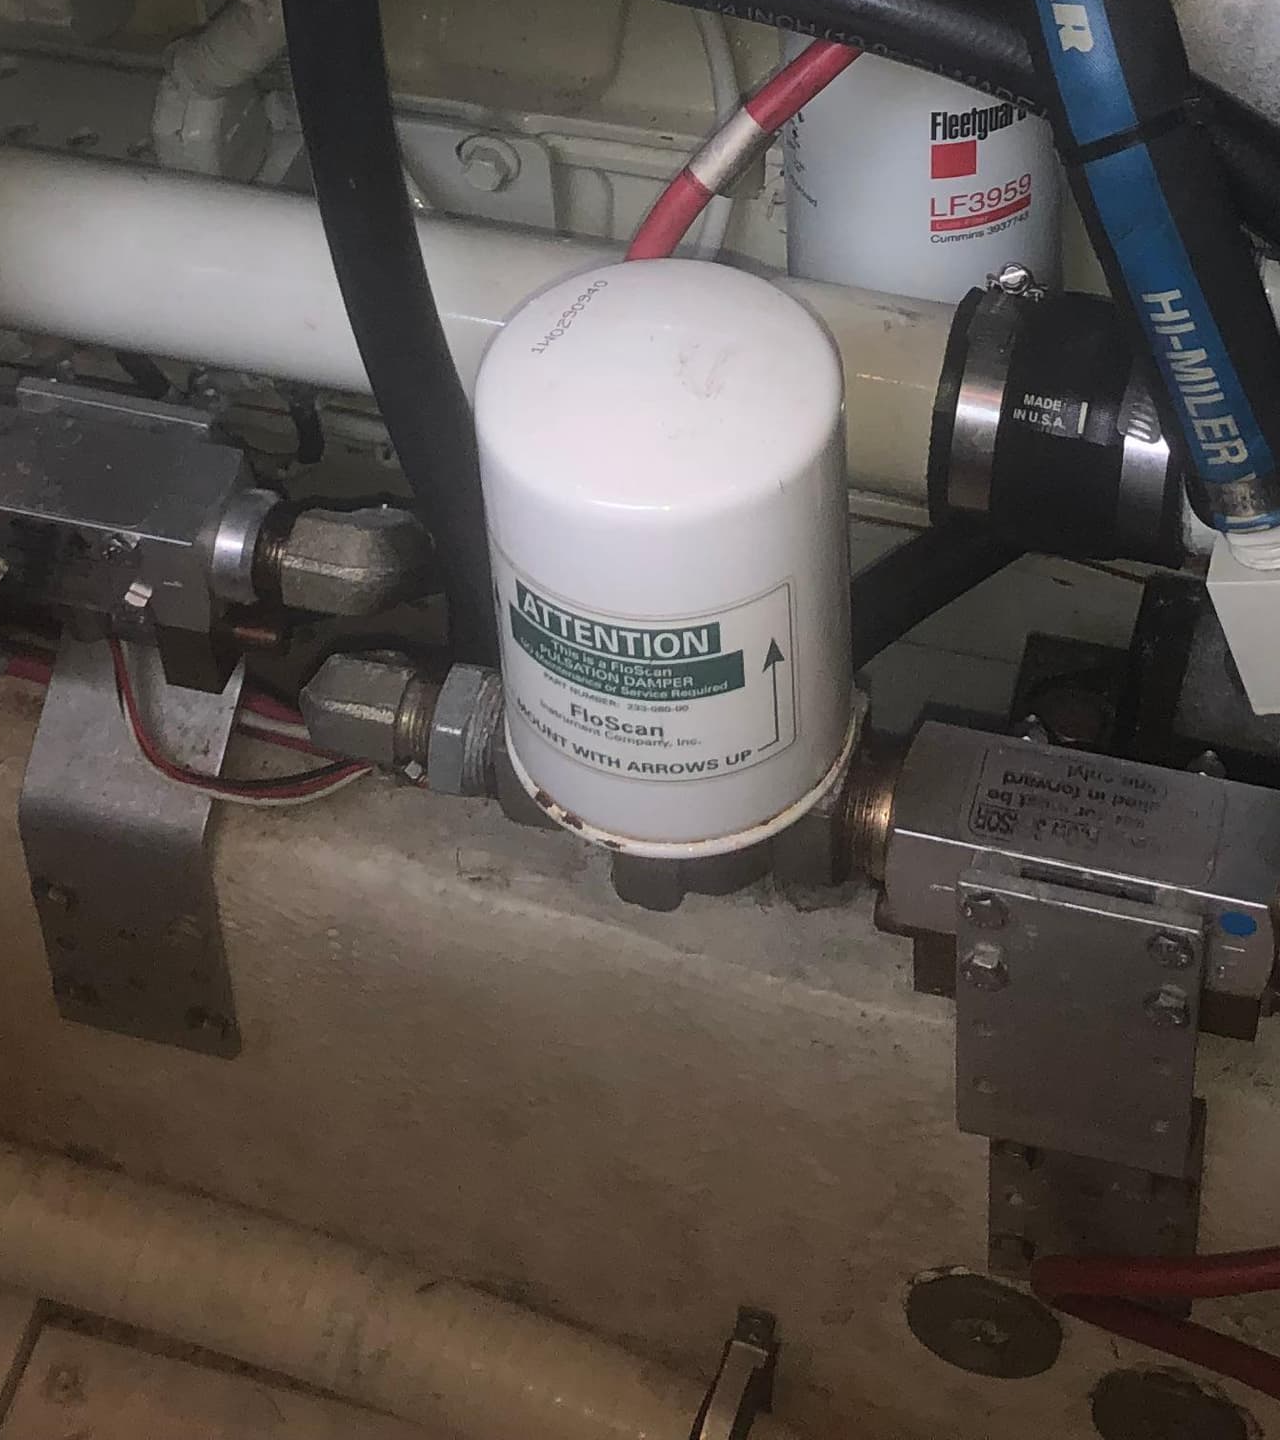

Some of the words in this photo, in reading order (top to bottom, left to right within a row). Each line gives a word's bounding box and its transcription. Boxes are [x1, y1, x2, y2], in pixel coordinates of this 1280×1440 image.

[931, 173, 1032, 218] LF3959
[931, 231, 985, 244] Cummins
[1142, 288, 1251, 466] HI-MILER
[1013, 408, 1027, 421] IN
[1024, 393, 1062, 412] MADE
[523, 592, 710, 659] ATTENTION
[540, 643, 620, 684] PULSATION
[624, 675, 694, 689] DAMPER
[550, 640, 579, 661] This
[582, 653, 595, 666] is
[611, 661, 673, 678] FloScan
[621, 685, 668, 698] Service
[671, 680, 728, 699] Required
[570, 702, 665, 737] FloScan
[571, 742, 621, 769] WITH
[627, 759, 720, 775] ARROWS
[725, 749, 753, 766] UP
